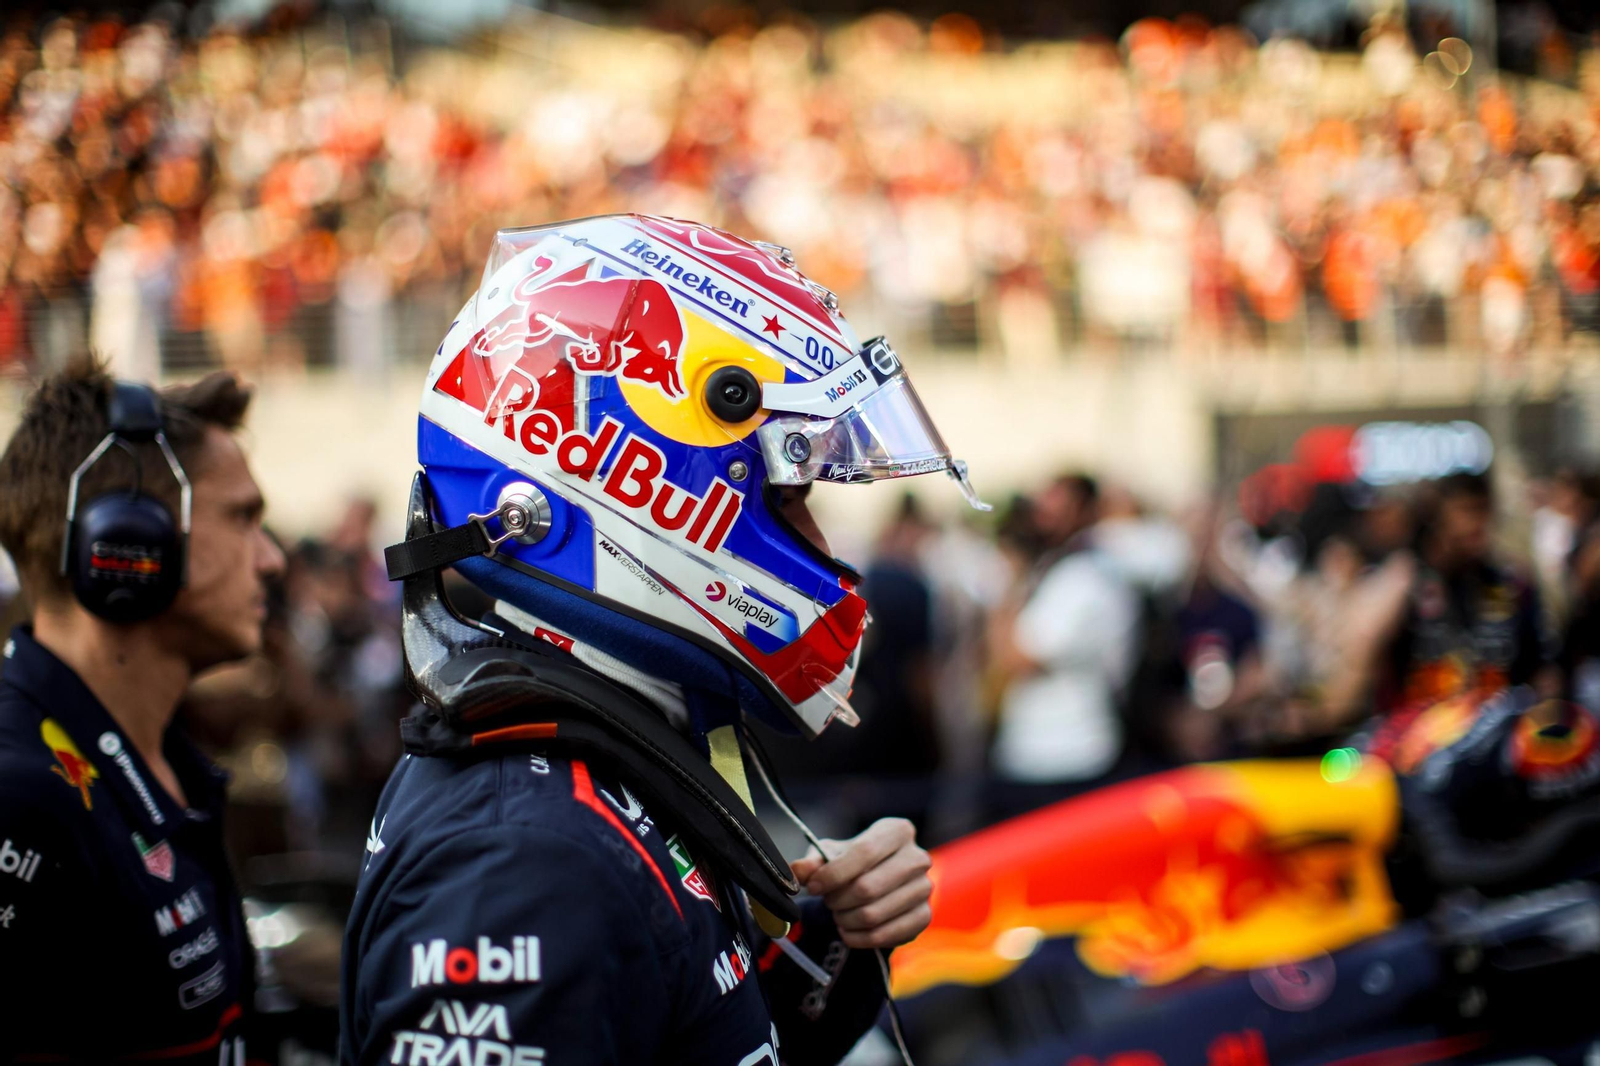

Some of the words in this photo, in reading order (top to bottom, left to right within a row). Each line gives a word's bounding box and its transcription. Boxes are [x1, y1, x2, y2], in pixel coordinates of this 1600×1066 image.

[825, 374, 858, 402] Mobil
[484, 367, 619, 483] Red
[603, 438, 740, 554] Bull
[728, 594, 779, 627] viaplay
[0, 839, 41, 883] bil
[411, 935, 541, 988] Mobil
[419, 999, 512, 1040] AVA
[391, 1030, 546, 1066] TRADE
